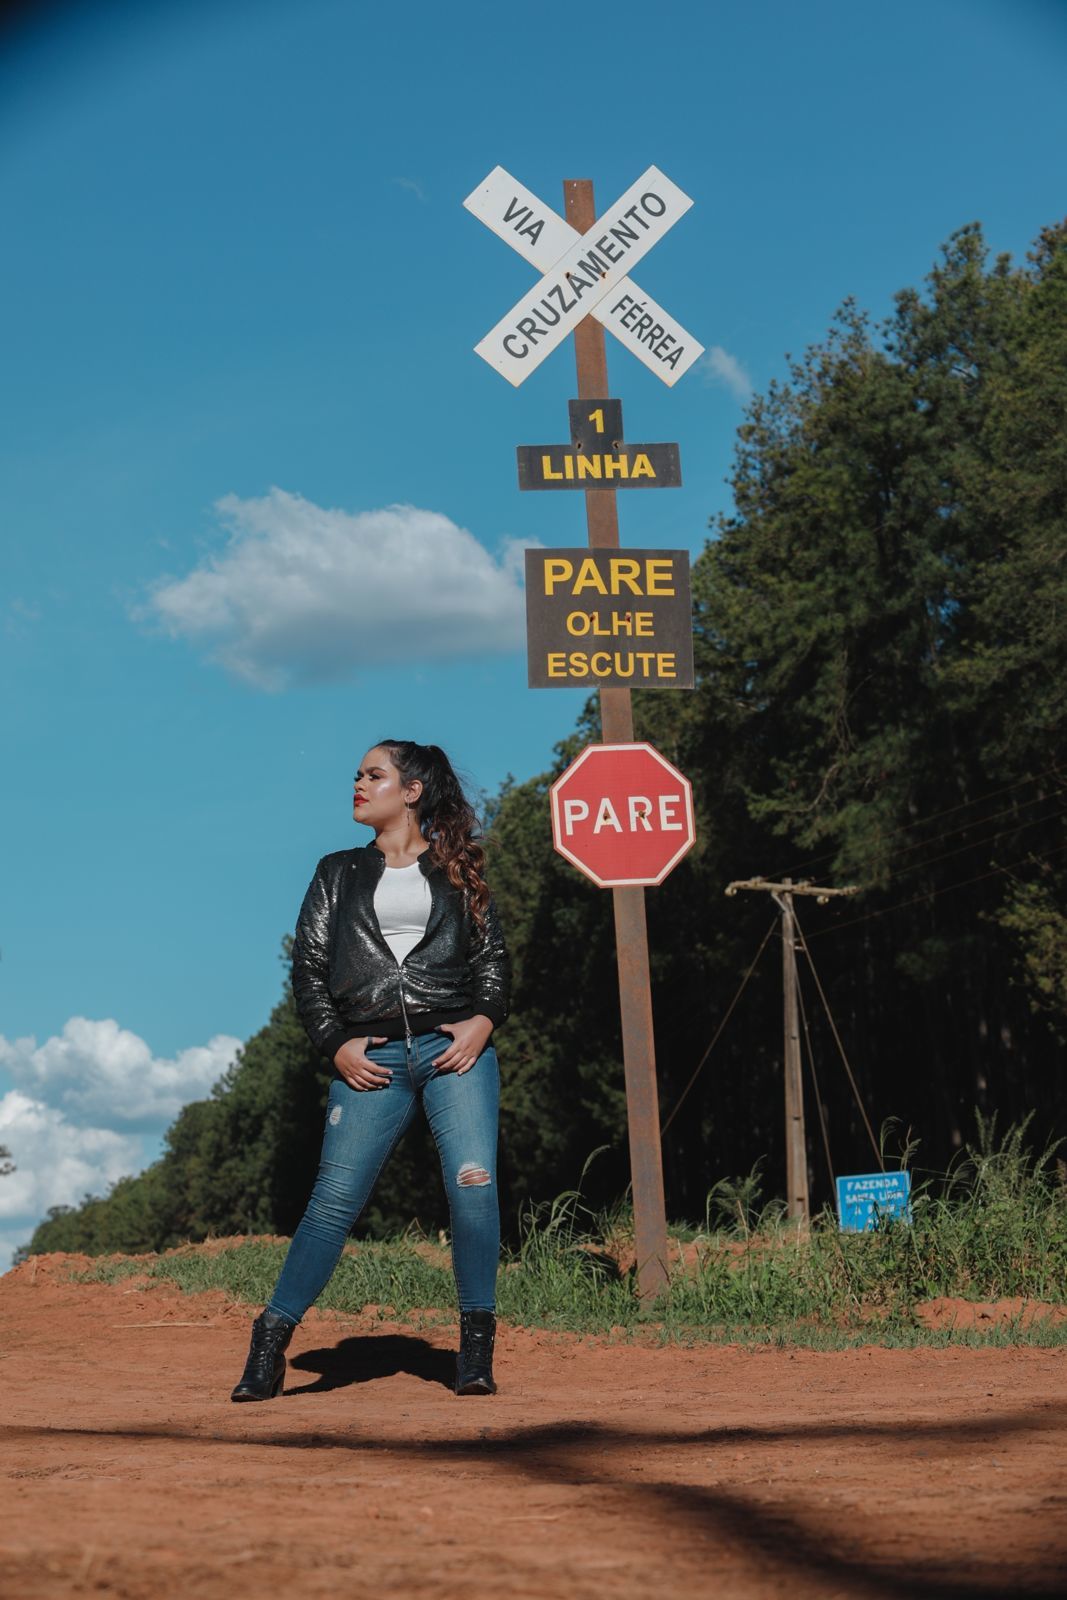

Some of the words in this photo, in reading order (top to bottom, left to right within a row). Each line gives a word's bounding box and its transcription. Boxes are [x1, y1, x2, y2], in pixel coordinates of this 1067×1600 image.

[502, 197, 545, 246] VIA
[502, 192, 667, 359] CRUZAMENTO
[610, 294, 685, 370] FÉRREA
[588, 408, 605, 433] 1
[541, 453, 657, 480] LINHA
[543, 557, 676, 597] PARE
[565, 610, 655, 637] OLHE
[546, 651, 677, 678] ESCUTE
[563, 794, 683, 836] PARE
[847, 1178, 899, 1191] FAZENDA
